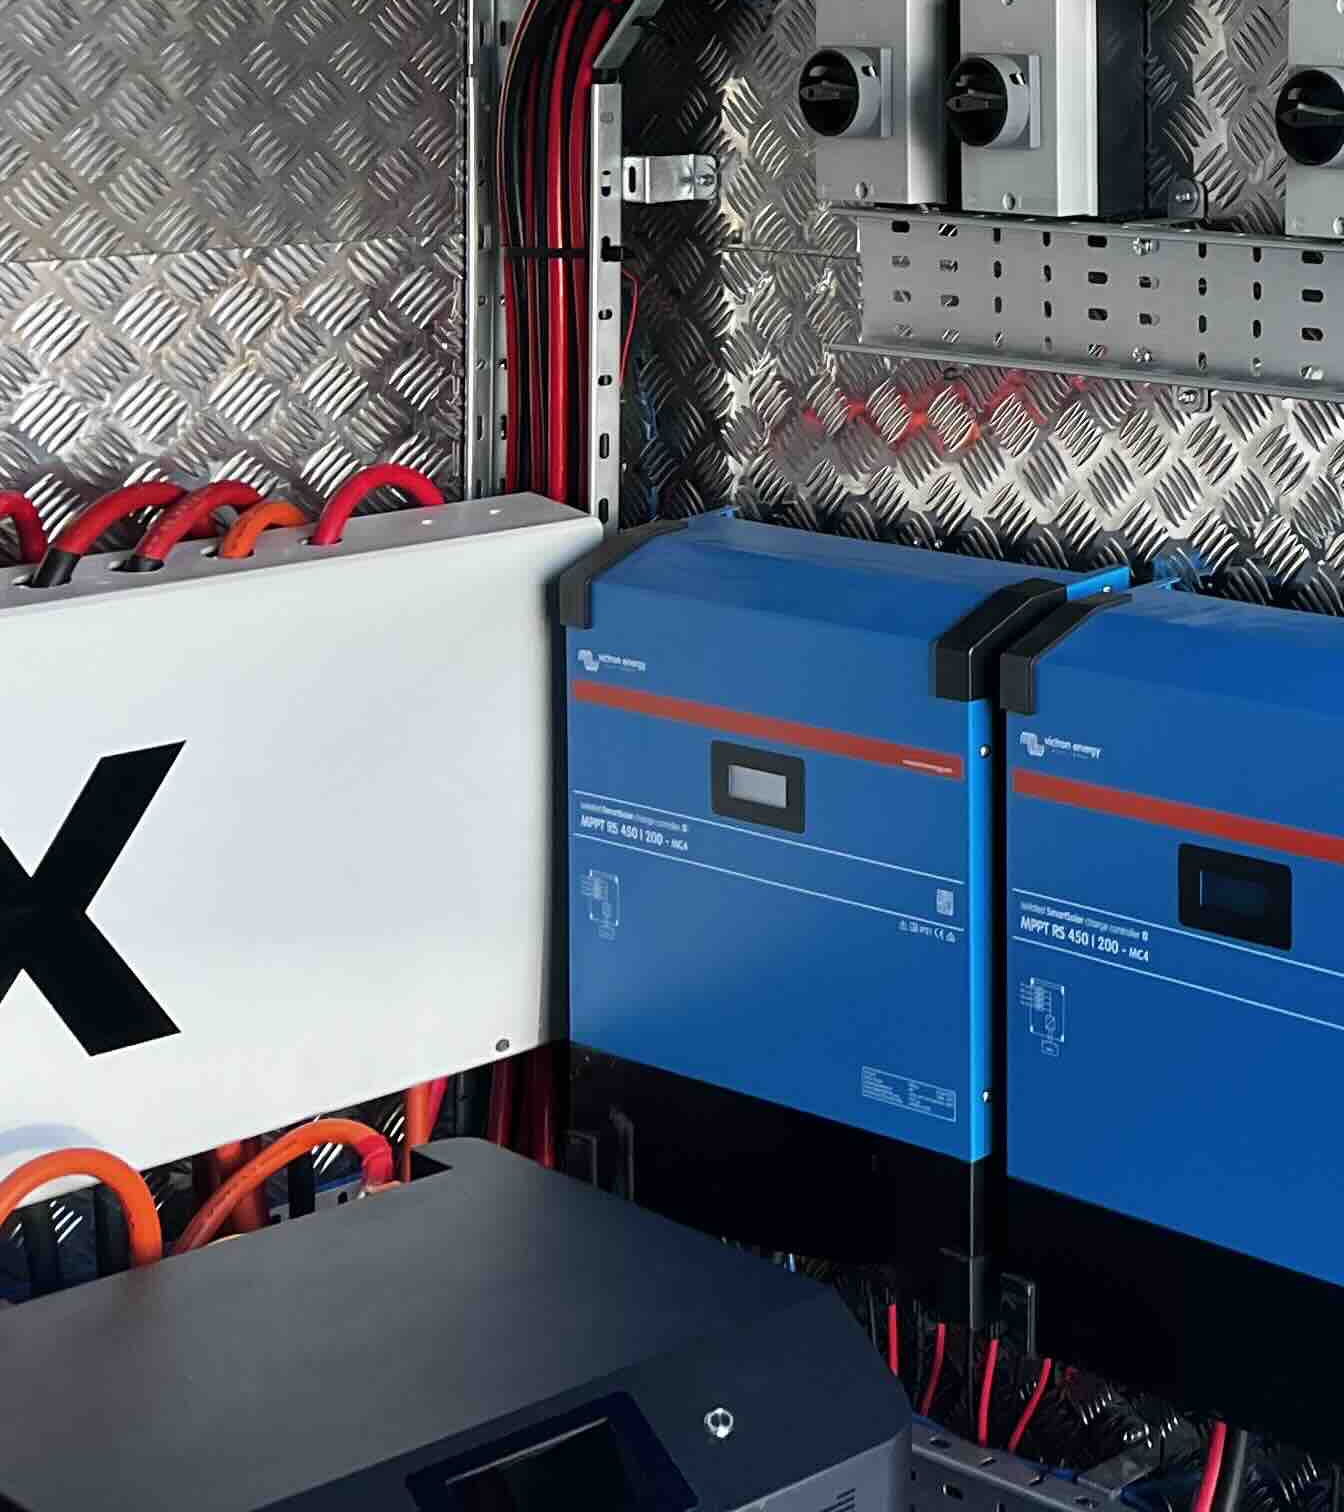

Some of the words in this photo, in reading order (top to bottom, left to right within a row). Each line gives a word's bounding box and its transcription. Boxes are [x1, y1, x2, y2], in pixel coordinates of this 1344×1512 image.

[645, 830, 664, 846] 200
[1020, 915, 1050, 936] MPPT
[1051, 923, 1065, 940] RS
[1067, 928, 1089, 946] 450
[1097, 935, 1119, 954] 200
[1128, 947, 1149, 962] MC4
